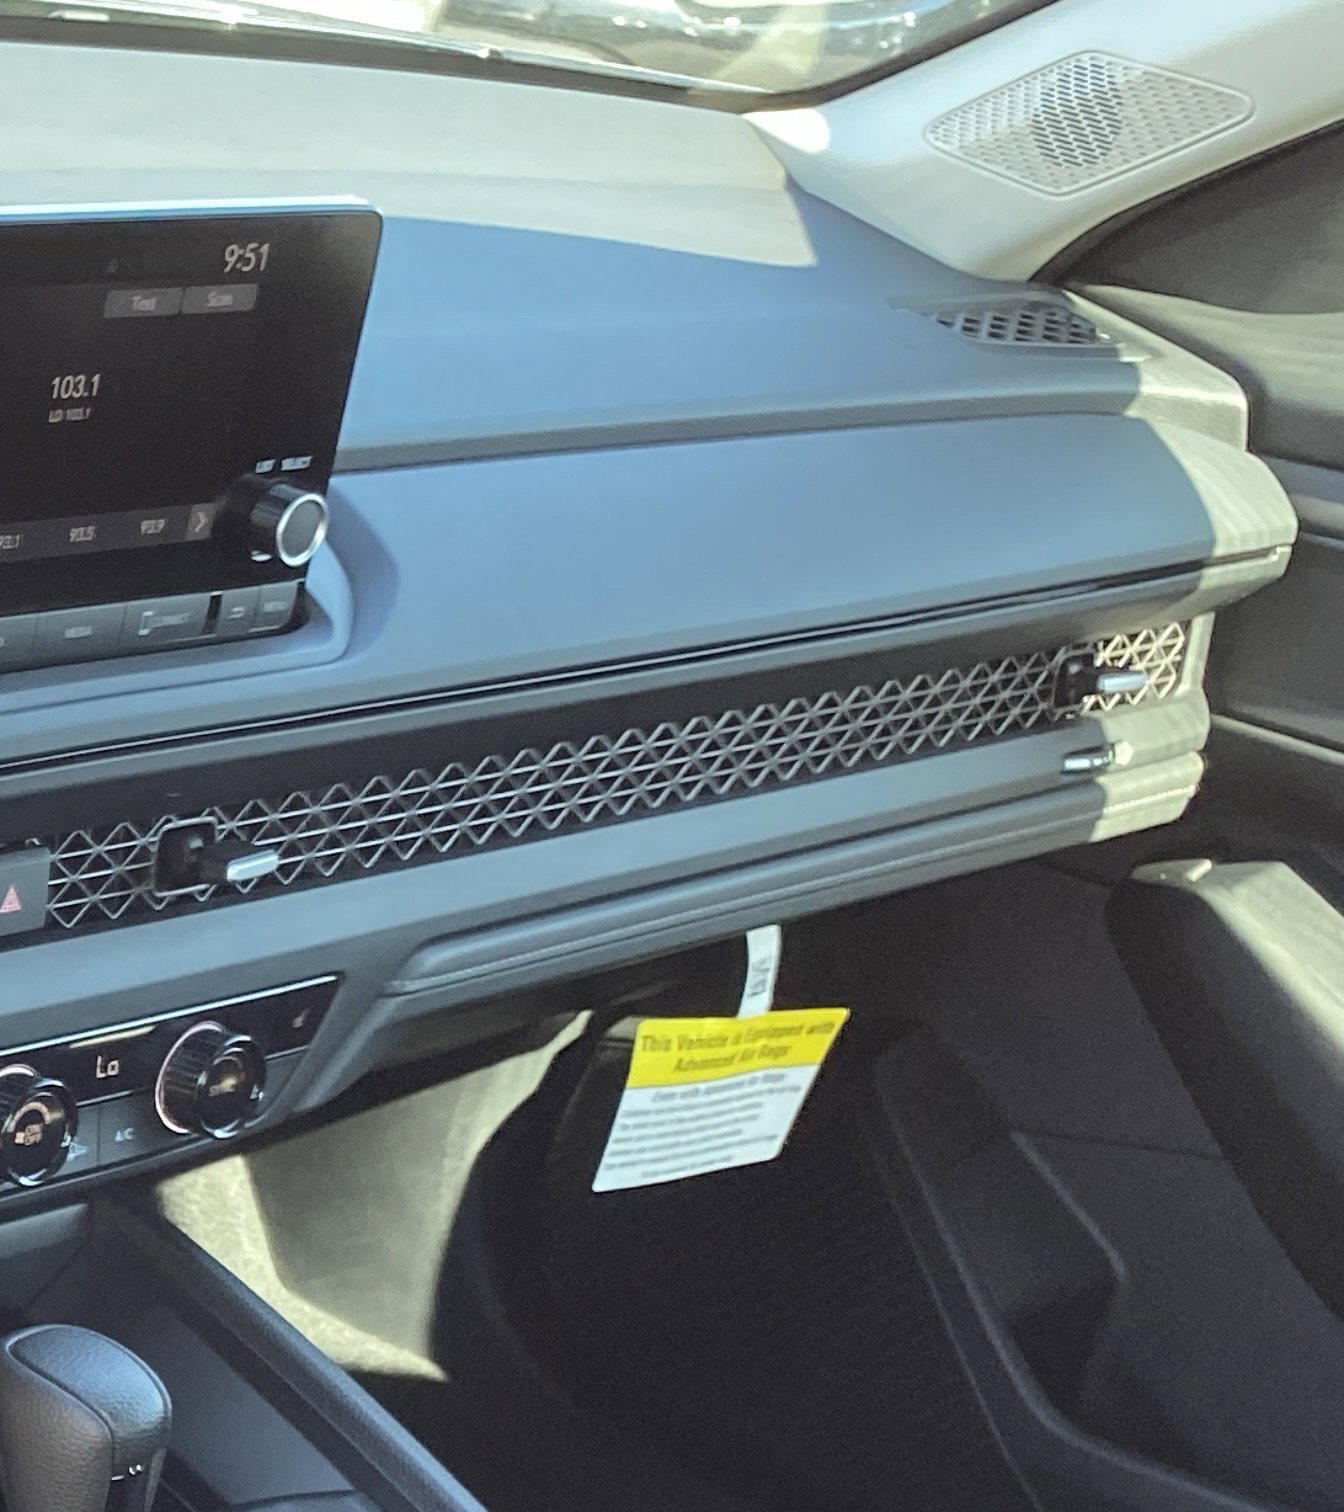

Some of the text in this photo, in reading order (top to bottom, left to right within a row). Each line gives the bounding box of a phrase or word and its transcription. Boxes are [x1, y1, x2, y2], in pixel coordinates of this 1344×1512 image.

[224, 242, 270, 273] 9:51
[51, 374, 101, 399] 103.1
[641, 1035, 672, 1052] This
